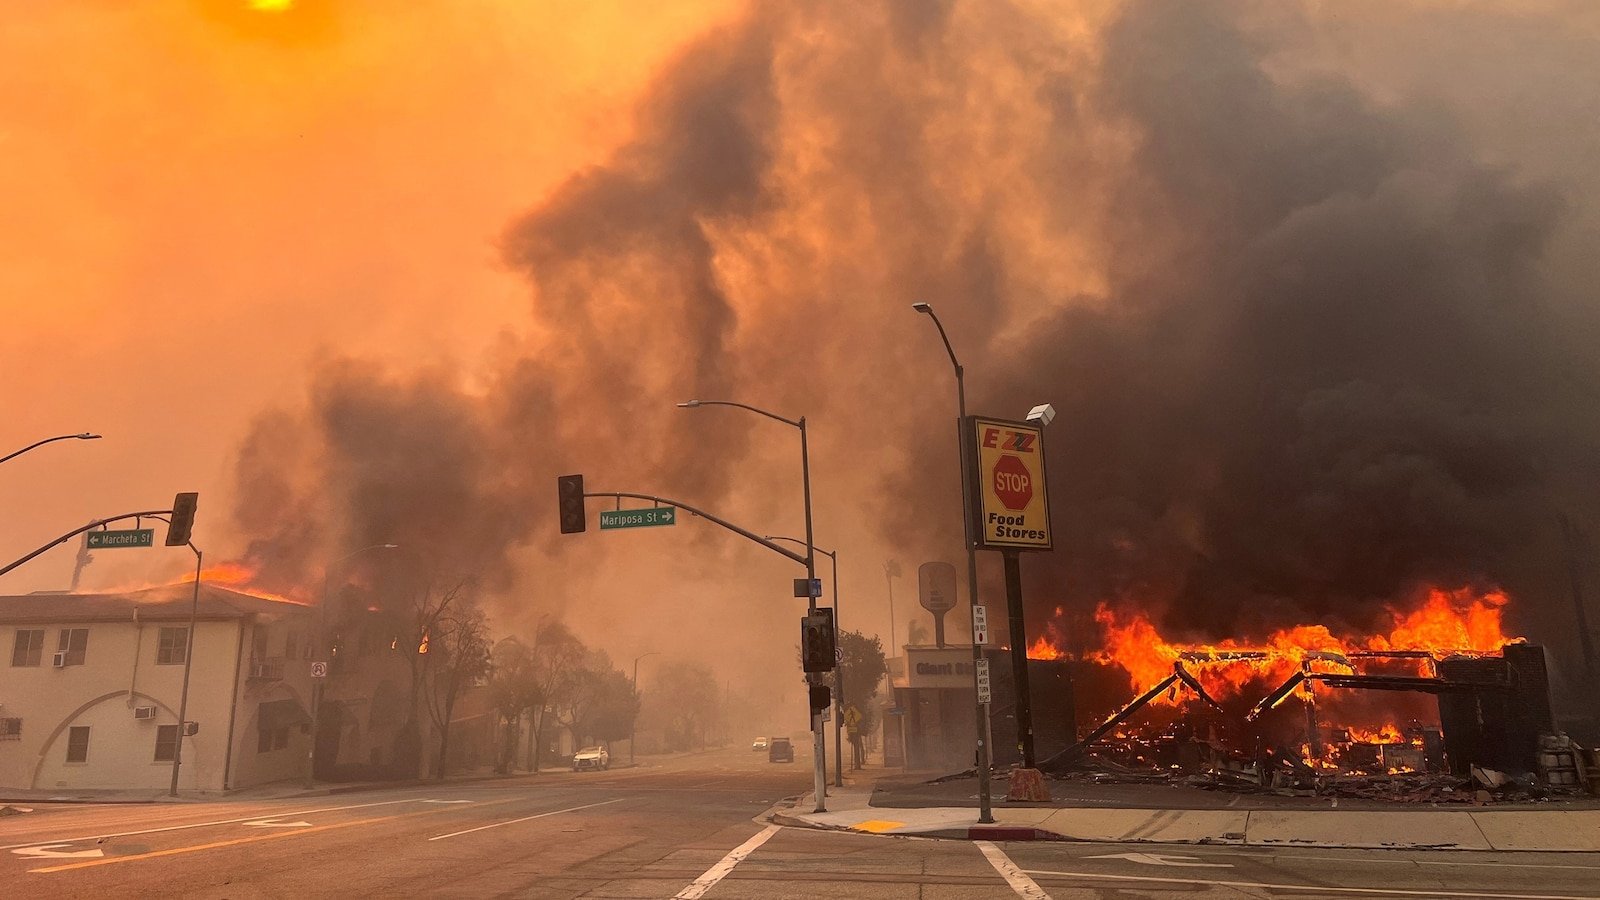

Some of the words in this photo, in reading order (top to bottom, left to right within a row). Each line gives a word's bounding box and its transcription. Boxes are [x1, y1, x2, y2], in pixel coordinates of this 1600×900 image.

[996, 471, 1029, 492] STOP
[601, 514, 643, 527] Mariposa
[646, 512, 658, 523] St
[988, 512, 1025, 526] Food
[102, 534, 138, 545] Marcheta
[141, 533, 150, 543] St
[995, 525, 1046, 540] Stores
